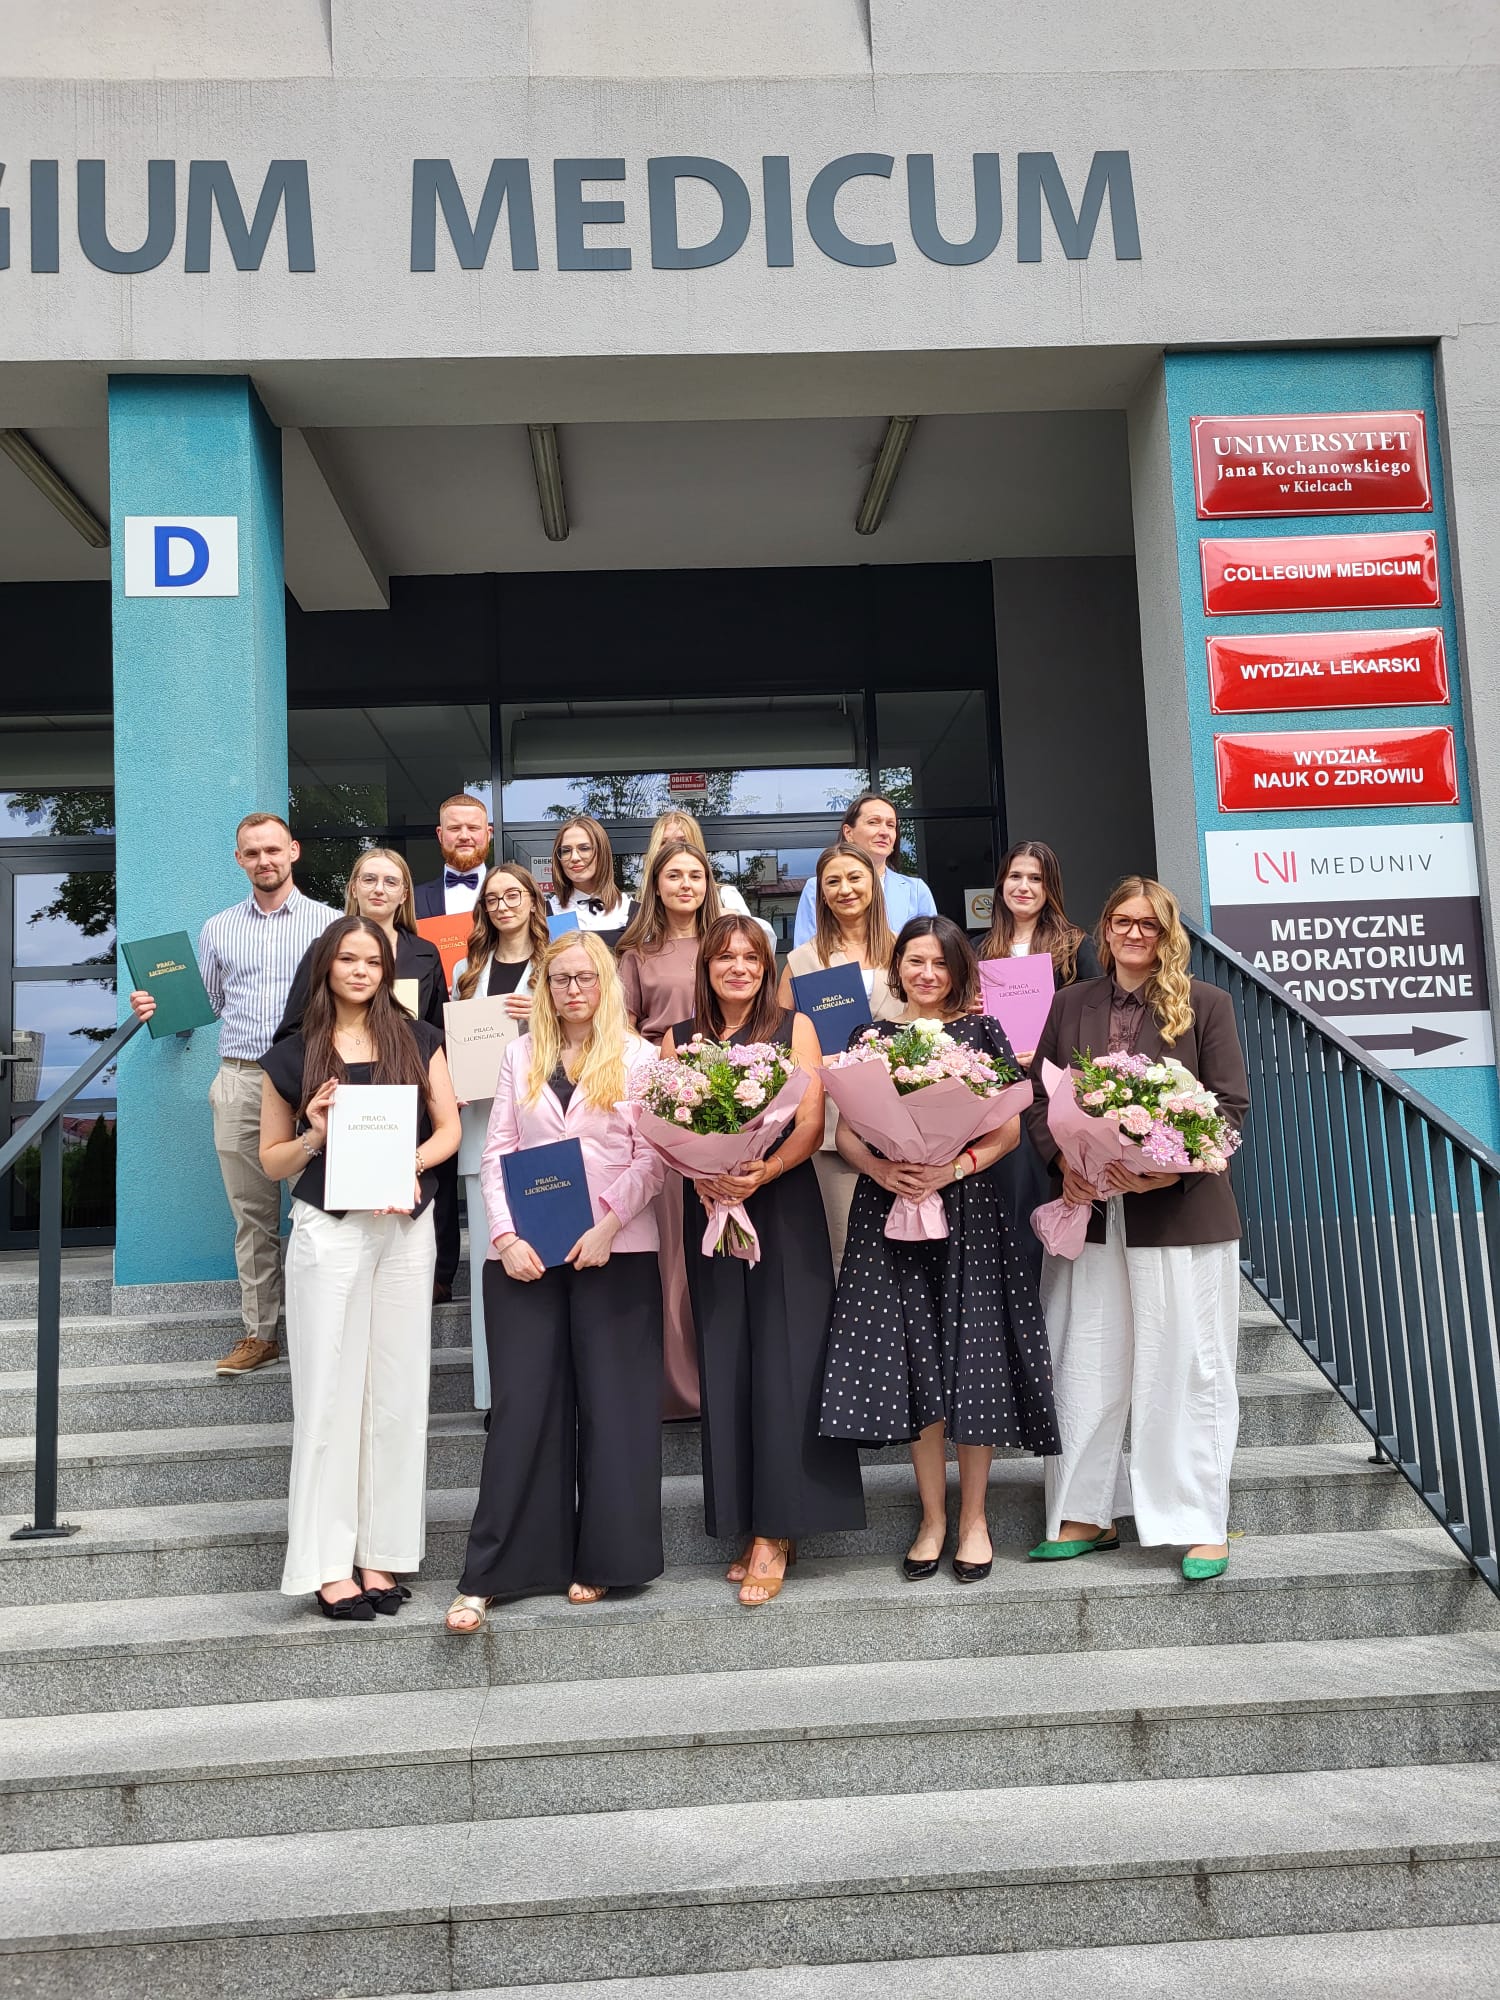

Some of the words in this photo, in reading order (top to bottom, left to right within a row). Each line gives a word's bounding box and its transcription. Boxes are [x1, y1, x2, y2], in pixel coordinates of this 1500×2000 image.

[0, 158, 315, 275] IUM
[410, 150, 1142, 272] MEDICUM
[1212, 430, 1411, 457] UNIWERSYTET
[1216, 462, 1257, 479] Jana
[1262, 458, 1412, 478] Kochanowskiego
[1279, 482, 1291, 493] w
[1293, 479, 1353, 493] Kielcach
[154, 526, 209, 587] D
[1223, 563, 1332, 582] COLLEGIUM
[1336, 560, 1422, 578] MEDICUM
[1240, 661, 1325, 681] WYDZIAŁ
[1329, 657, 1421, 676] LEKARSKI
[1293, 748, 1382, 766] WYDZIAŁ
[1254, 772, 1309, 789] NAUK
[1313, 770, 1328, 787] O
[1333, 767, 1425, 786] ZDROWIU
[1310, 854, 1433, 875] MEDUNIV
[1270, 914, 1426, 942] MEDYCZNE
[1236, 943, 1466, 973] ABORATORIUM
[821, 993, 843, 1003] PRACA
[1284, 974, 1474, 1002] GNOSTYCZNE
[473, 1025, 494, 1034] PRACA
[534, 1175, 560, 1186] PRACA
